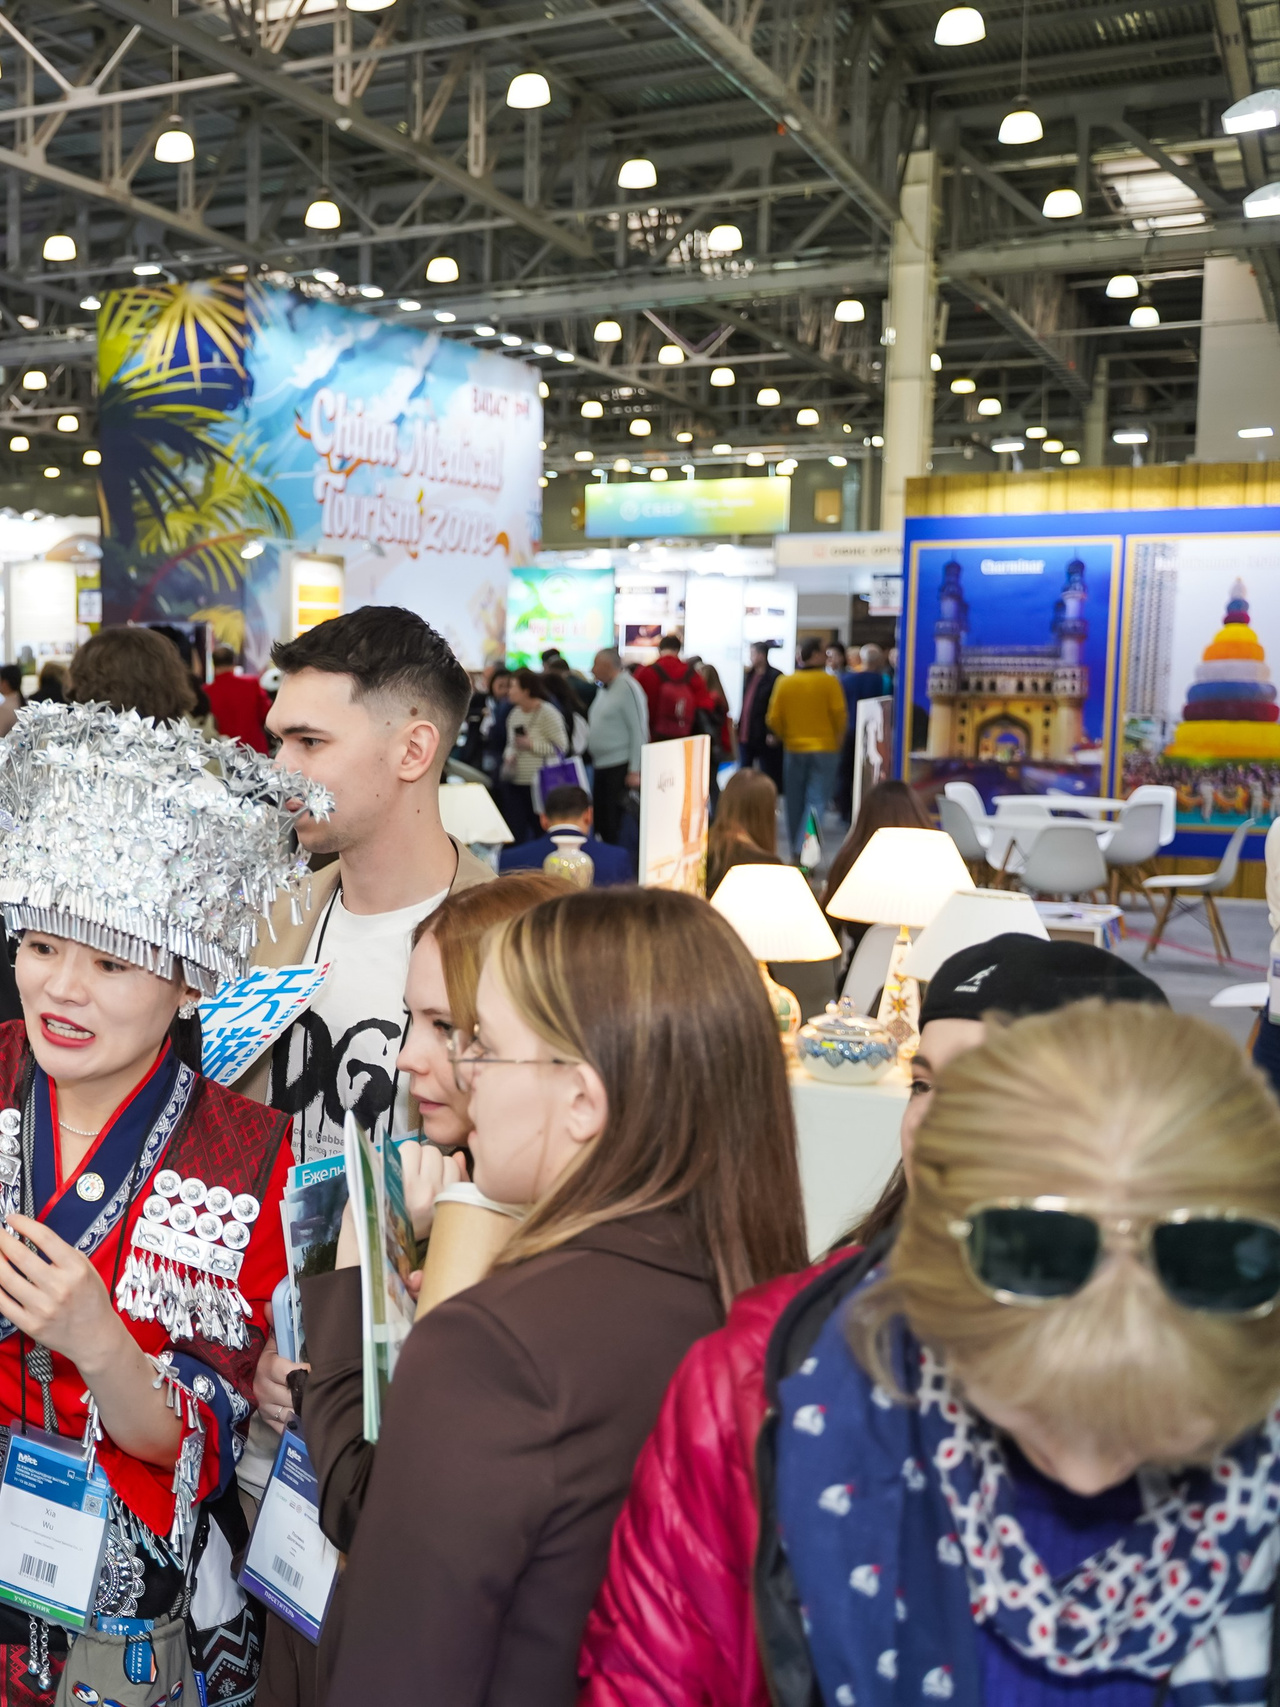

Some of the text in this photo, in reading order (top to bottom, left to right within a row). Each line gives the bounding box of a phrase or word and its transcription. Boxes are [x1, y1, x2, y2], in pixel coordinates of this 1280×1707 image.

[311, 387, 398, 468] China
[314, 470, 499, 555] Tourism zone
[45, 1508, 57, 1518] Xia
[42, 1520, 54, 1531] Wu
[14, 1595, 51, 1614] УЧАСТНИК
